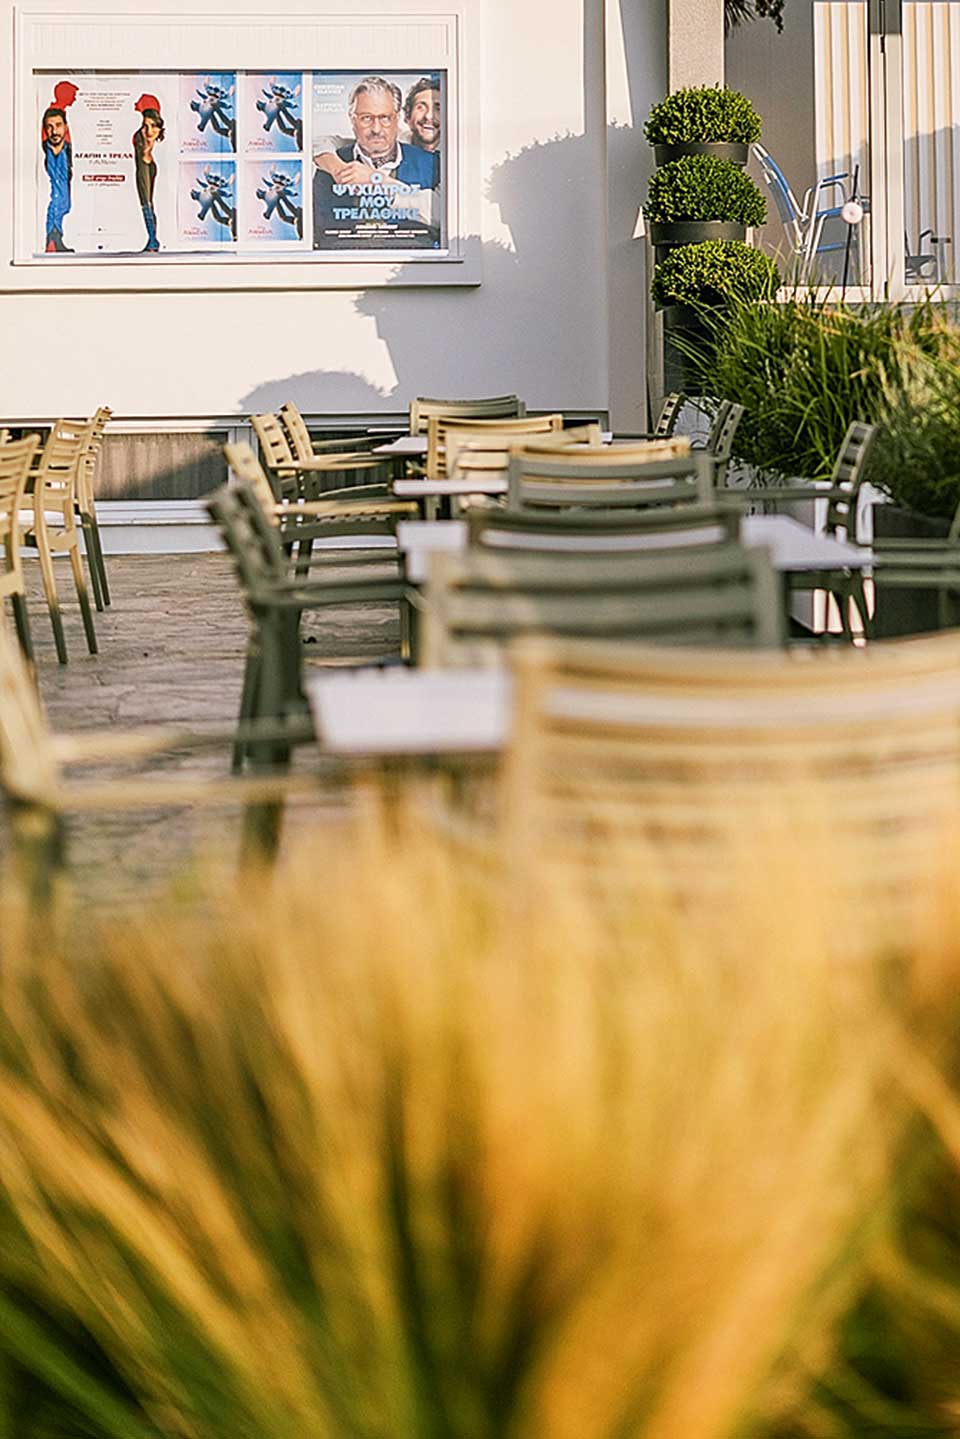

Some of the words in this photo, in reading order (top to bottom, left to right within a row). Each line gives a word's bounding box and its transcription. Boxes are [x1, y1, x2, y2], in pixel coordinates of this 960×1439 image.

[332, 184, 421, 196] ΨΥΧΙΑΤΡΟΣ
[360, 196, 395, 208] ΜΟΥ
[333, 208, 421, 220] ΤΡΕΛΑΘΗΚΕ
